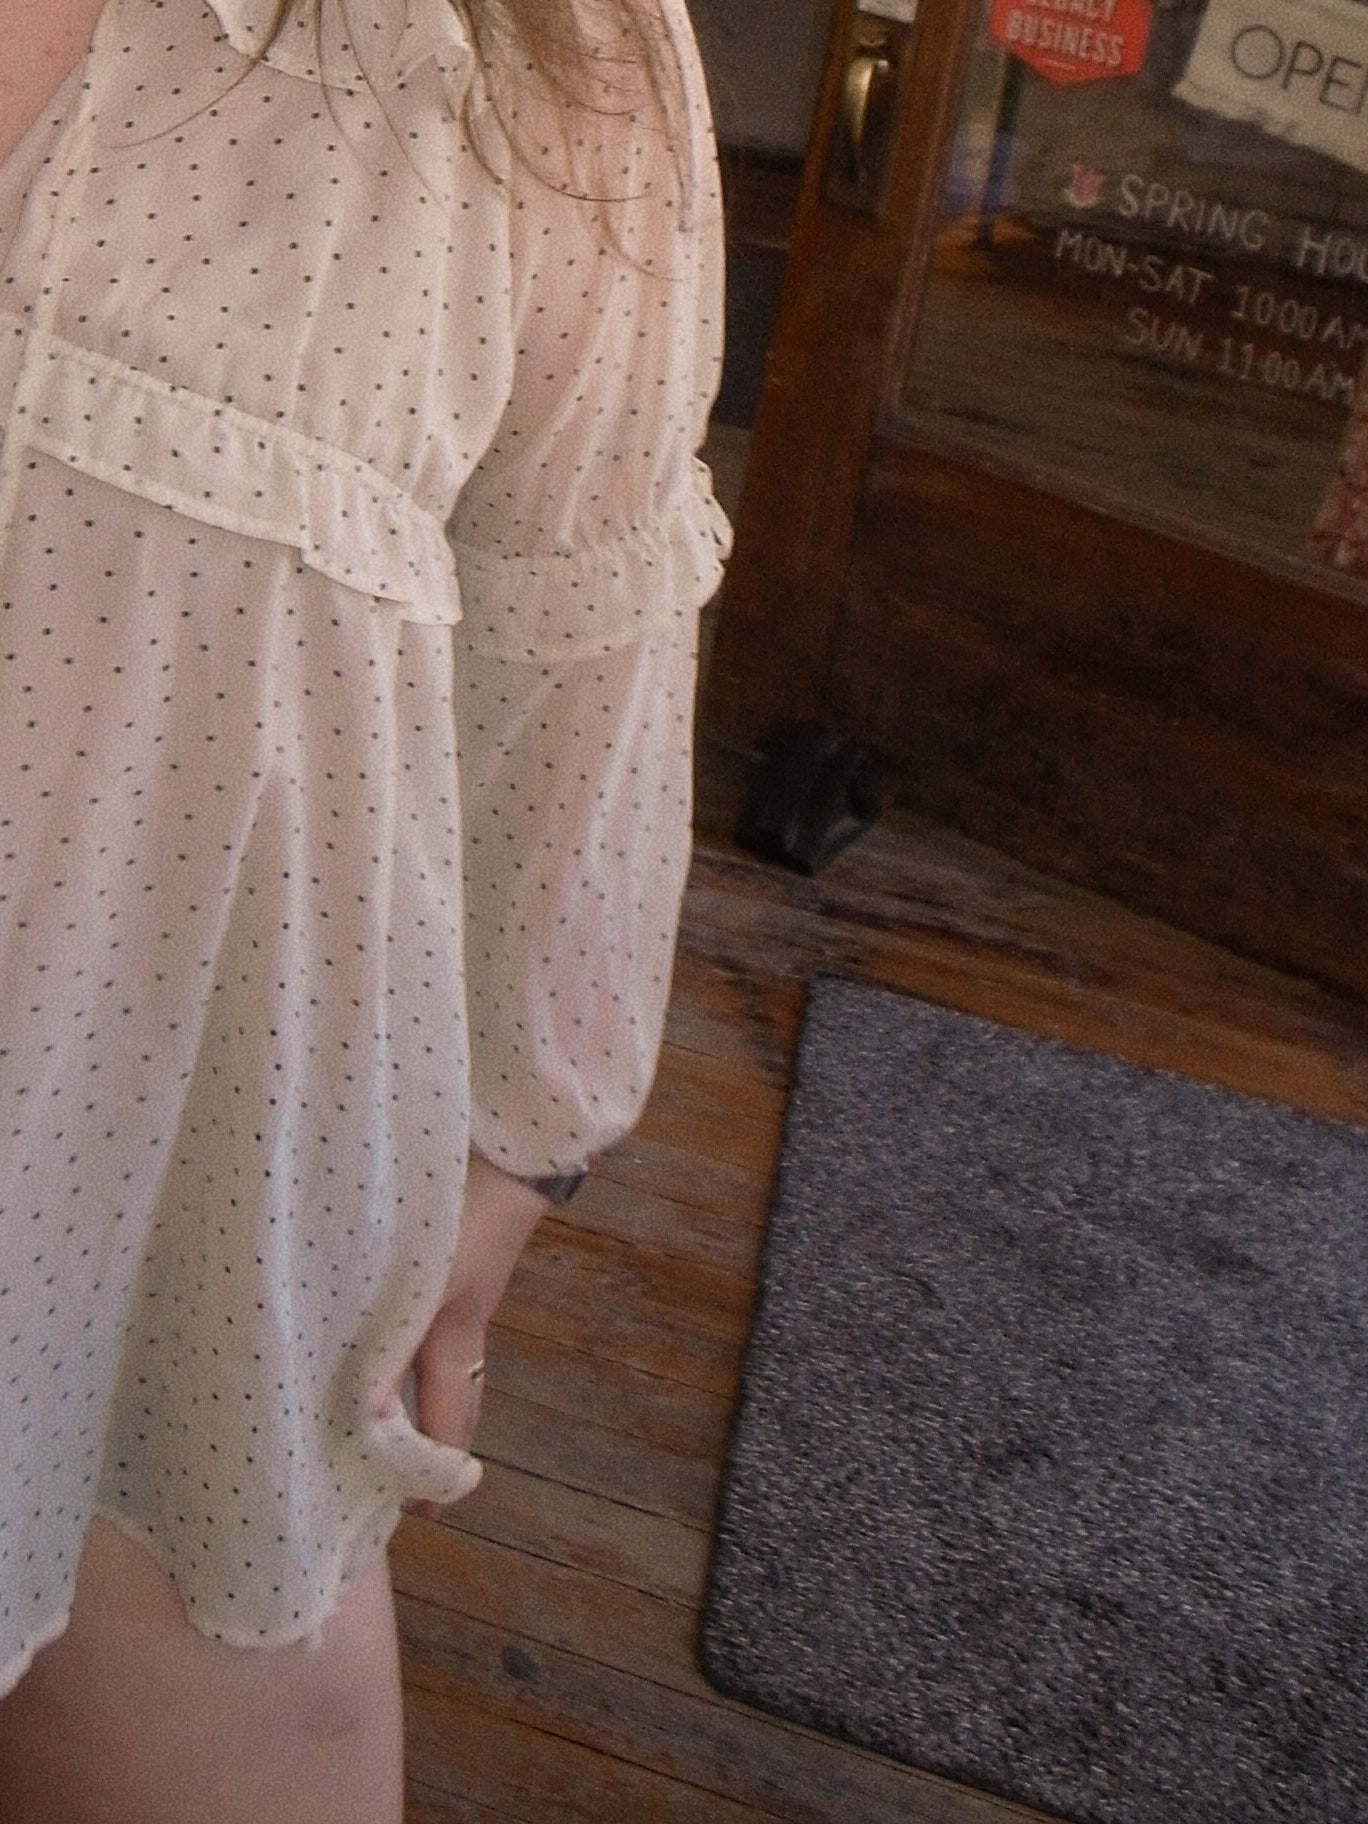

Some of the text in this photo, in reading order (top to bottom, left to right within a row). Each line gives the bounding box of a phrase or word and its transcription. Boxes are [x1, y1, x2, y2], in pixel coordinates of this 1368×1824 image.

[1006, 9, 1124, 68] BUSINESS
[1118, 173, 1271, 251] SPRING
[1125, 306, 1205, 362] SUN
